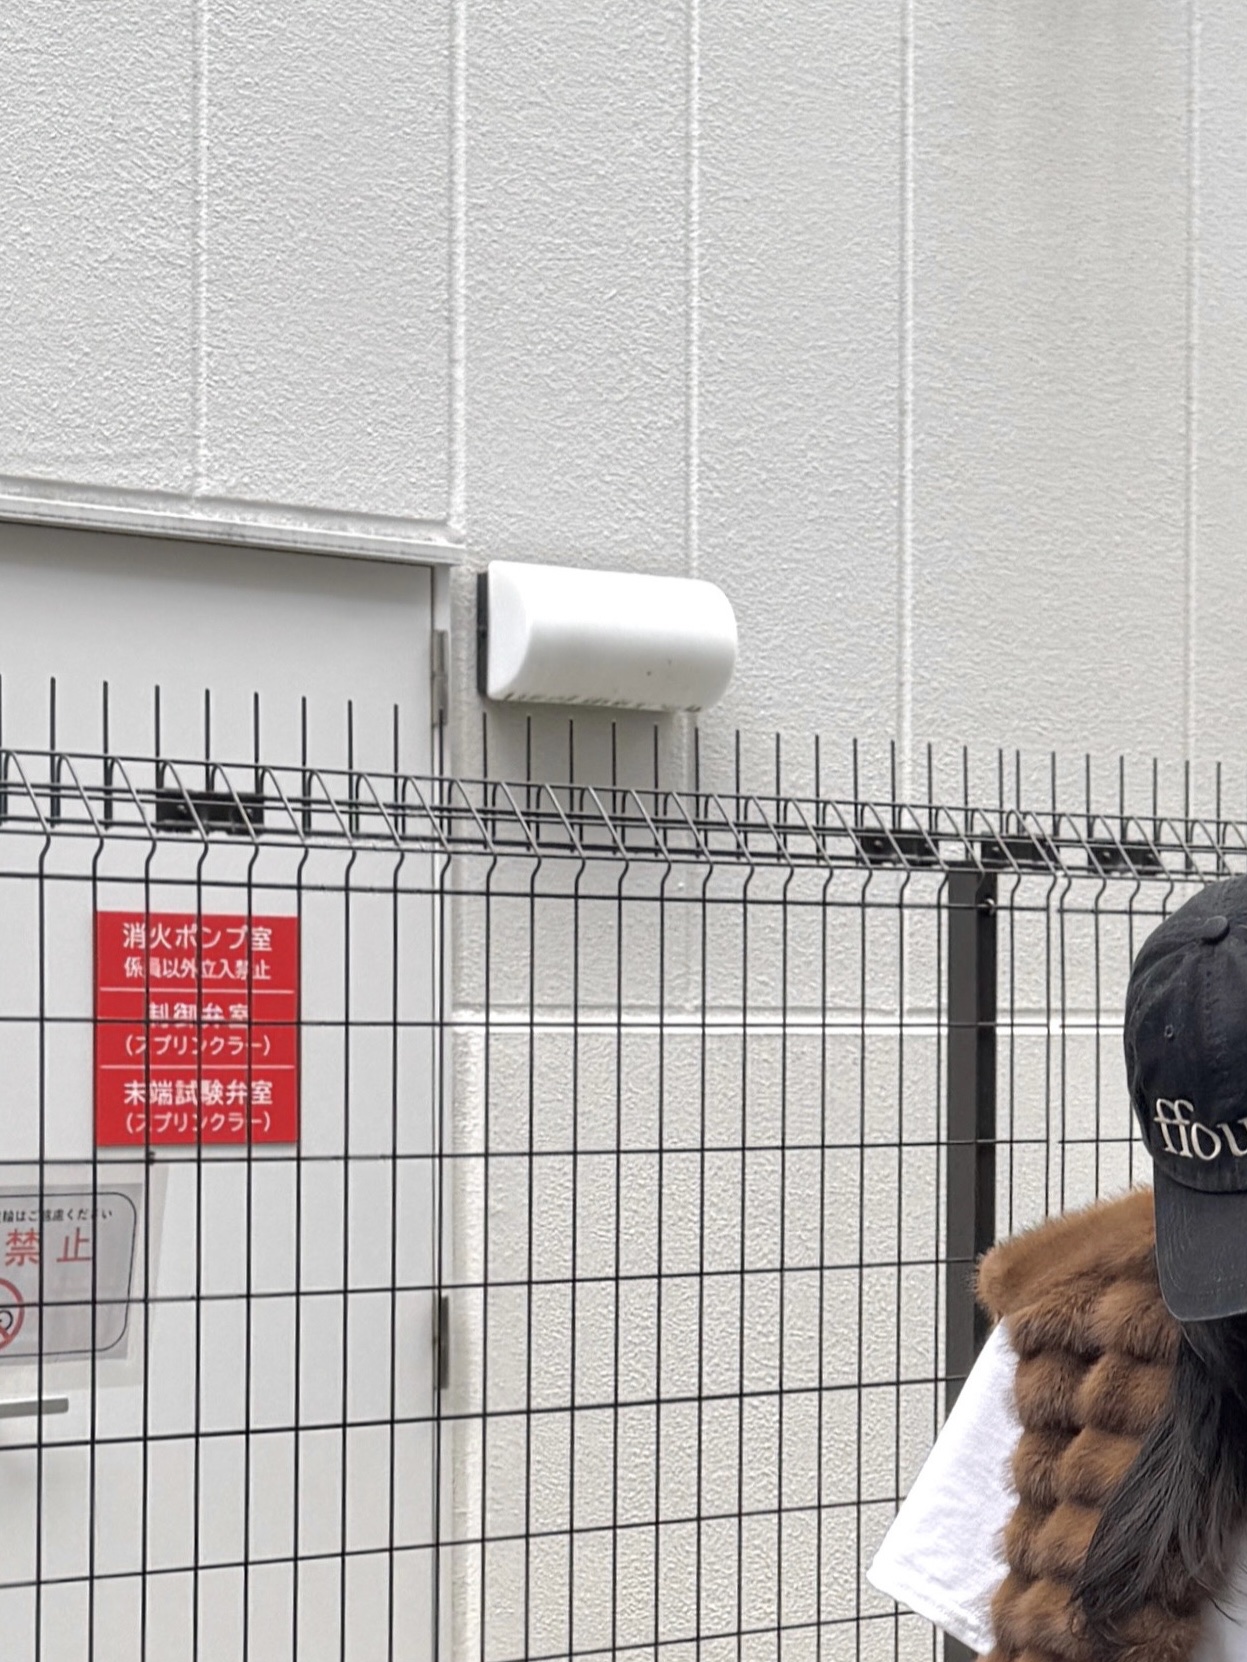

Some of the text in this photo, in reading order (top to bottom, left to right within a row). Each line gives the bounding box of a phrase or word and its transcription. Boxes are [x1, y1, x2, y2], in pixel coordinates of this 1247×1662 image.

[123, 922, 272, 952] 消火ポンプ室
[124, 956, 271, 980] 係員以外立入禁止
[123, 1079, 273, 1106] 末端試験弁室
[5, 1227, 92, 1267] 禁止
